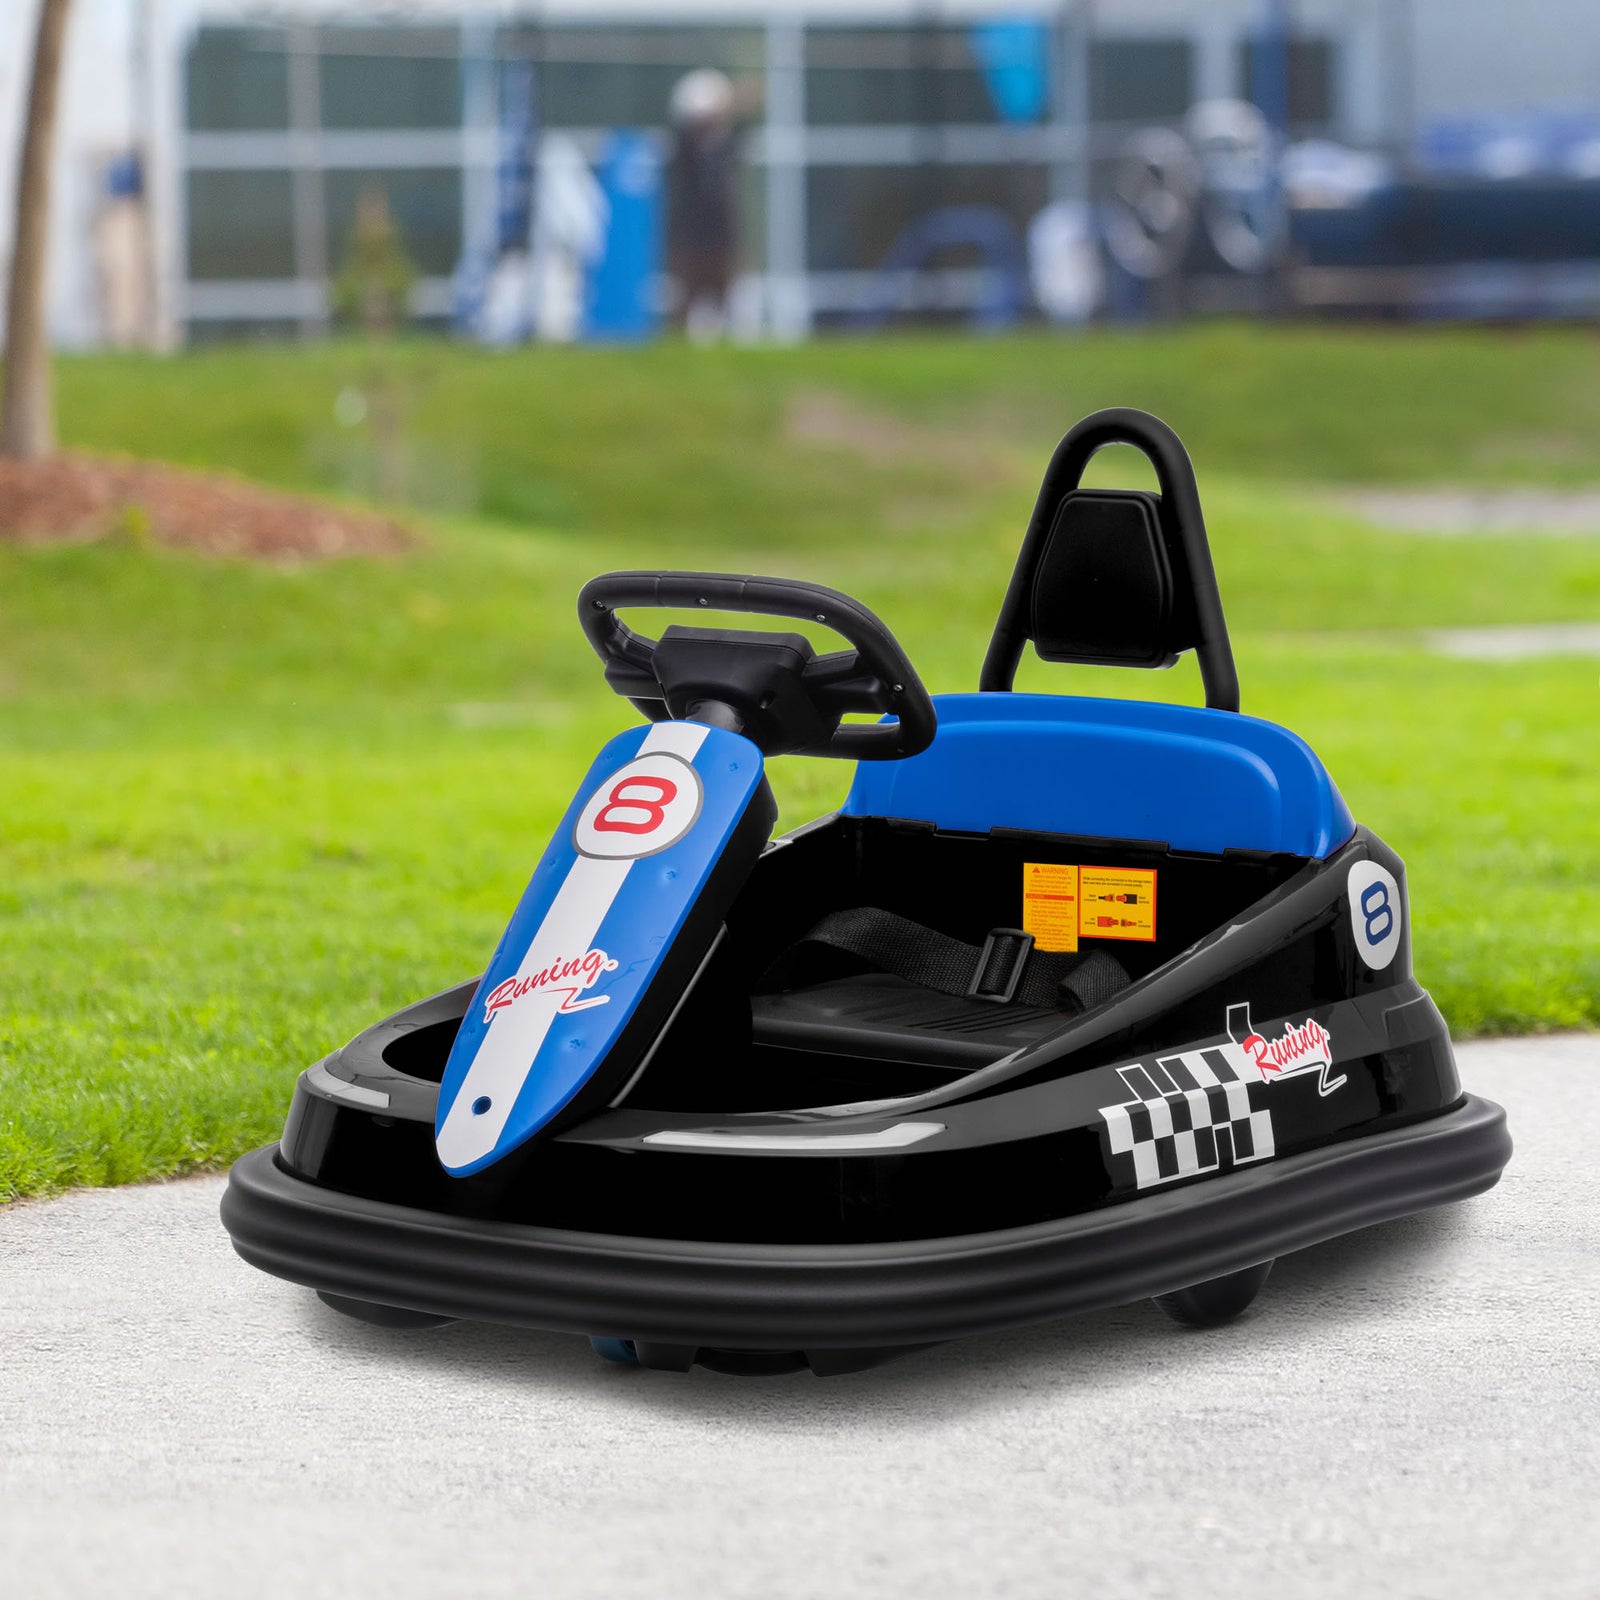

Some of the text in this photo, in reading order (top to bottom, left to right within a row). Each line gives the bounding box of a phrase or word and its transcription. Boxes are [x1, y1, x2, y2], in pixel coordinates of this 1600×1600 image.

[593, 776, 677, 834] 8
[1040, 866, 1069, 875] WARNING
[1361, 881, 1394, 946] 8
